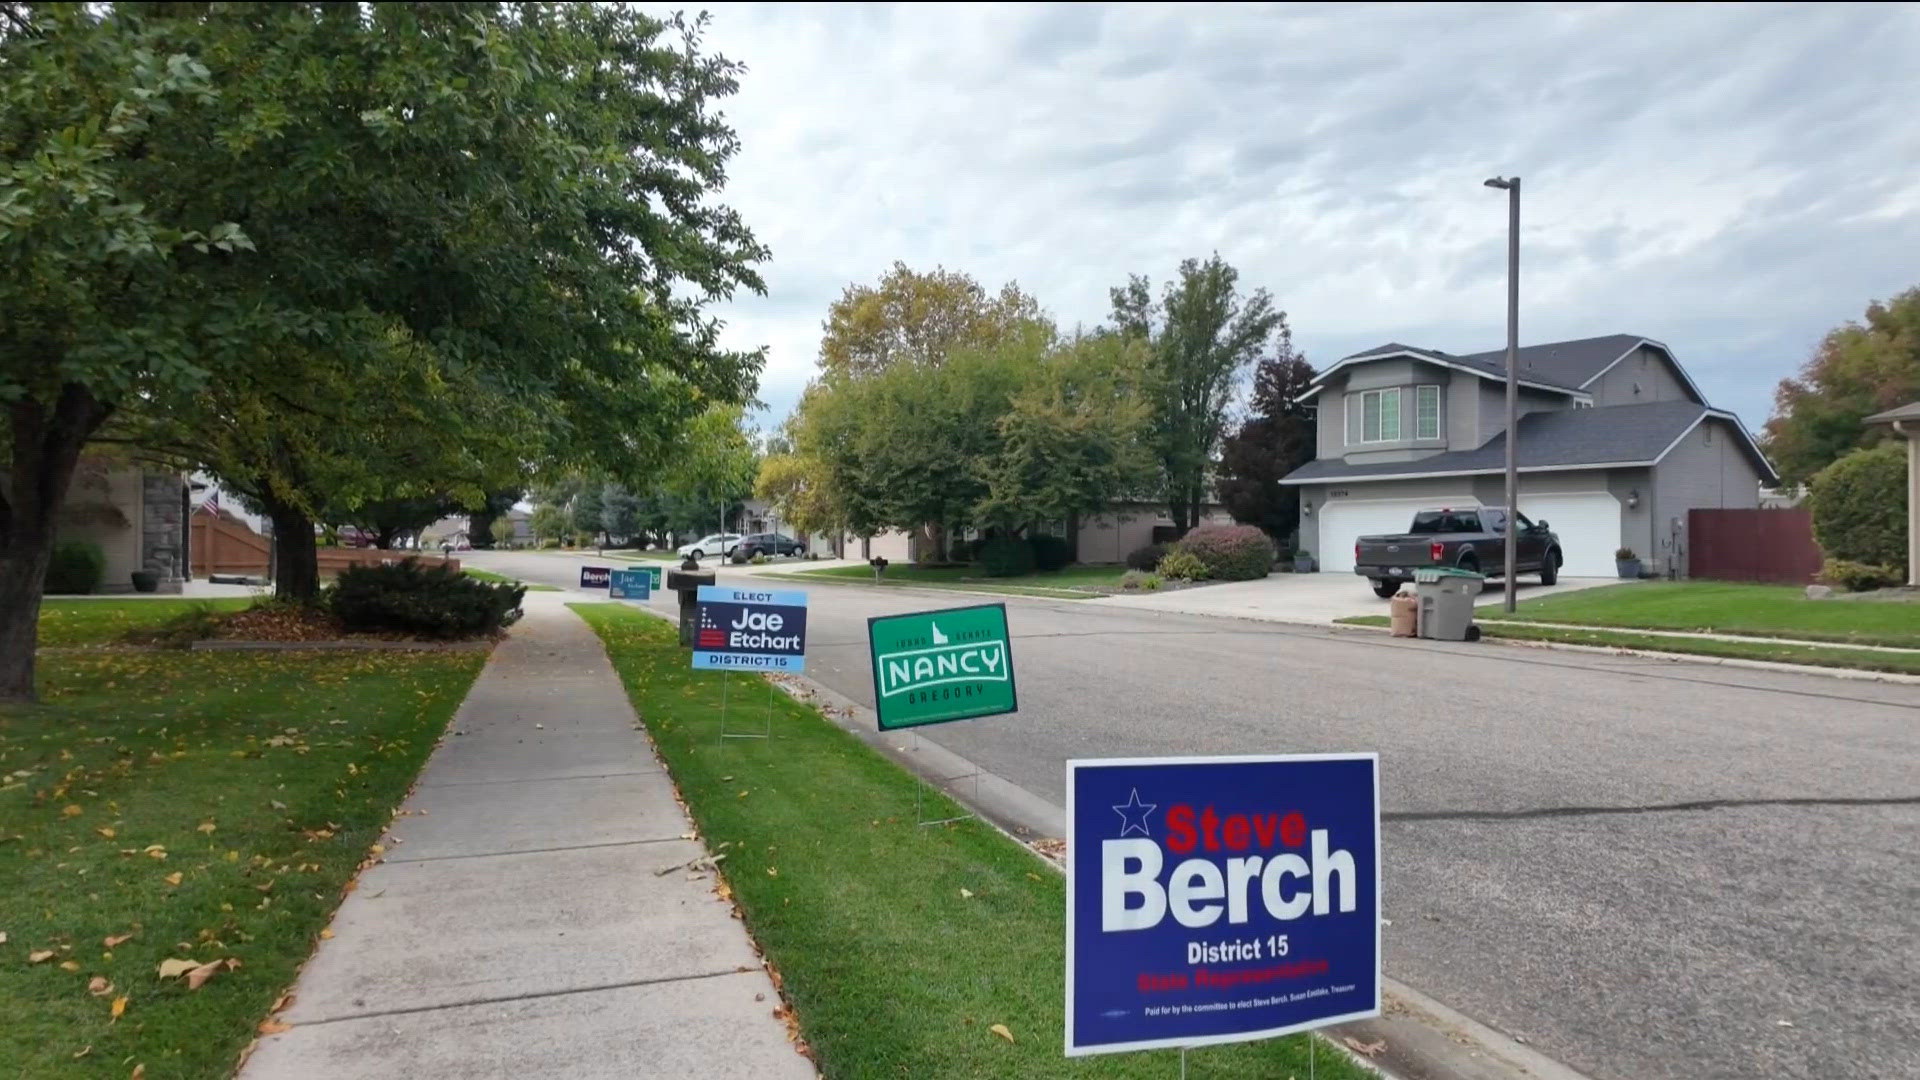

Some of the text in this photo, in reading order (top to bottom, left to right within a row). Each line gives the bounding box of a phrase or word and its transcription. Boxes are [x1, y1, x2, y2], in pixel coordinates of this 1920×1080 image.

[733, 591, 773, 602] ELECT
[731, 607, 783, 632] Jae
[729, 631, 800, 650] Etchart
[709, 655, 787, 667] DISTRICT 15
[889, 648, 1000, 688] NANCY
[909, 684, 983, 705] GREGORY
[1165, 802, 1307, 854] Steve
[1101, 829, 1356, 933] Berch
[1187, 935, 1289, 964] District 15
[1145, 1006, 1160, 1016] Paid
[1161, 1005, 1171, 1014] for
[1172, 1005, 1180, 1015] by
[1181, 1004, 1192, 1013] the
[1229, 1001, 1236, 1010] to
[1237, 1000, 1252, 1009] elect
[1253, 998, 1270, 1007] Steve
